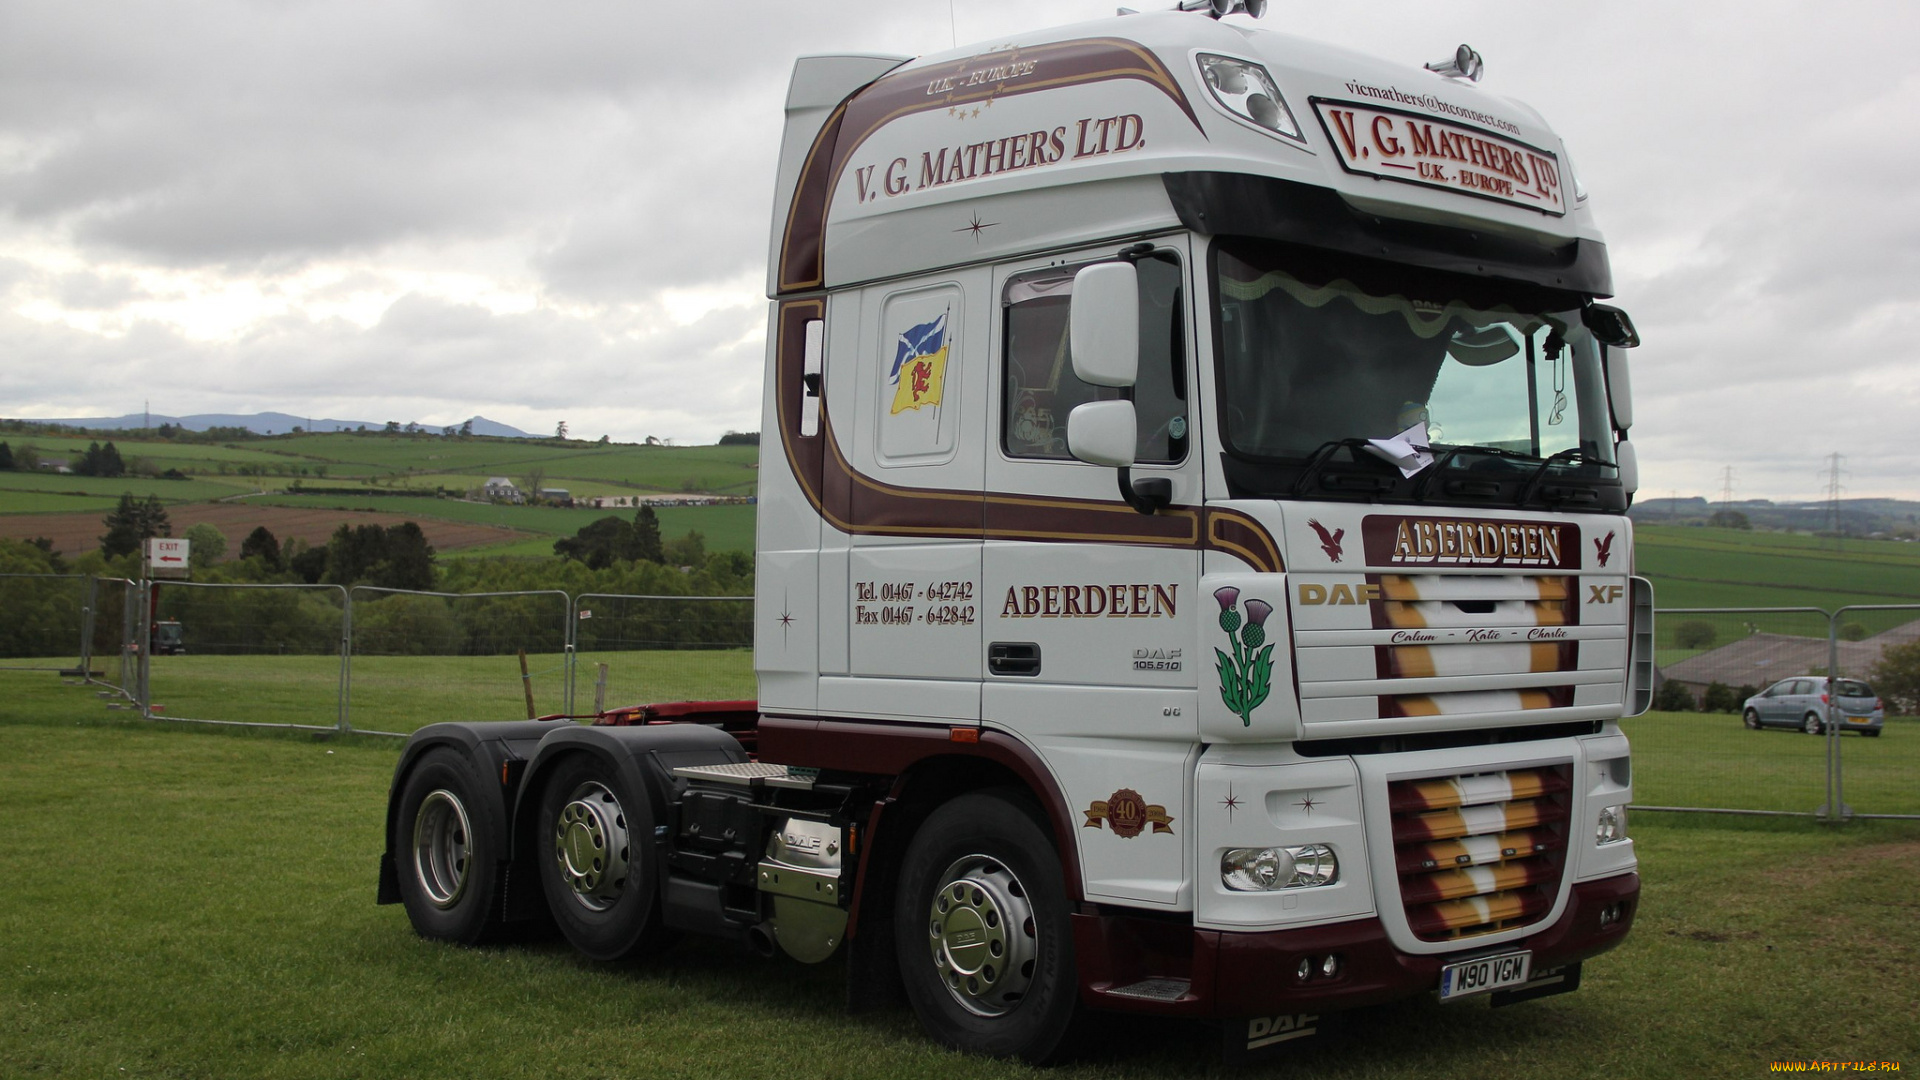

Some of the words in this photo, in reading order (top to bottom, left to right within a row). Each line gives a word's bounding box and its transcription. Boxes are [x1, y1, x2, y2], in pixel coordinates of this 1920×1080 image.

[967, 60, 1037, 87] EUROPE
[1345, 79, 1521, 136] vicmathers@btconnect.com
[855, 164, 876, 204] V.
[883, 157, 910, 198] G.
[916, 126, 1066, 191] MATHERS
[1071, 113, 1146, 160] LTD.
[1330, 109, 1369, 160] V.
[1371, 115, 1406, 158] G.
[1406, 120, 1530, 186] MATHERS
[1526, 152, 1558, 204] LTD.
[1417, 161, 1449, 182] U.K.
[1459, 169, 1514, 198] EUROPE
[159, 543, 178, 551] EXIT
[1392, 518, 1562, 566] ABERDEEN
[855, 581, 878, 601] Tel.
[881, 582, 914, 602] 01467
[927, 581, 973, 602] 642742
[1000, 583, 1178, 618] ABERDEEN
[1299, 583, 1380, 606] DAF
[1587, 584, 1624, 605] XF
[855, 605, 879, 625] Fax
[881, 605, 914, 626] 01467
[926, 605, 975, 626] 642842
[1391, 630, 1438, 644] Calum
[1465, 628, 1501, 642] Katie
[1527, 627, 1568, 640] Charlie
[1133, 647, 1182, 659] DAF
[1133, 661, 1179, 670] 105.510
[1116, 800, 1135, 820] 40
[786, 834, 820, 849] DAF
[1457, 963, 1489, 991] M90
[1494, 957, 1523, 983] VGM
[1248, 1013, 1319, 1039] DAF
